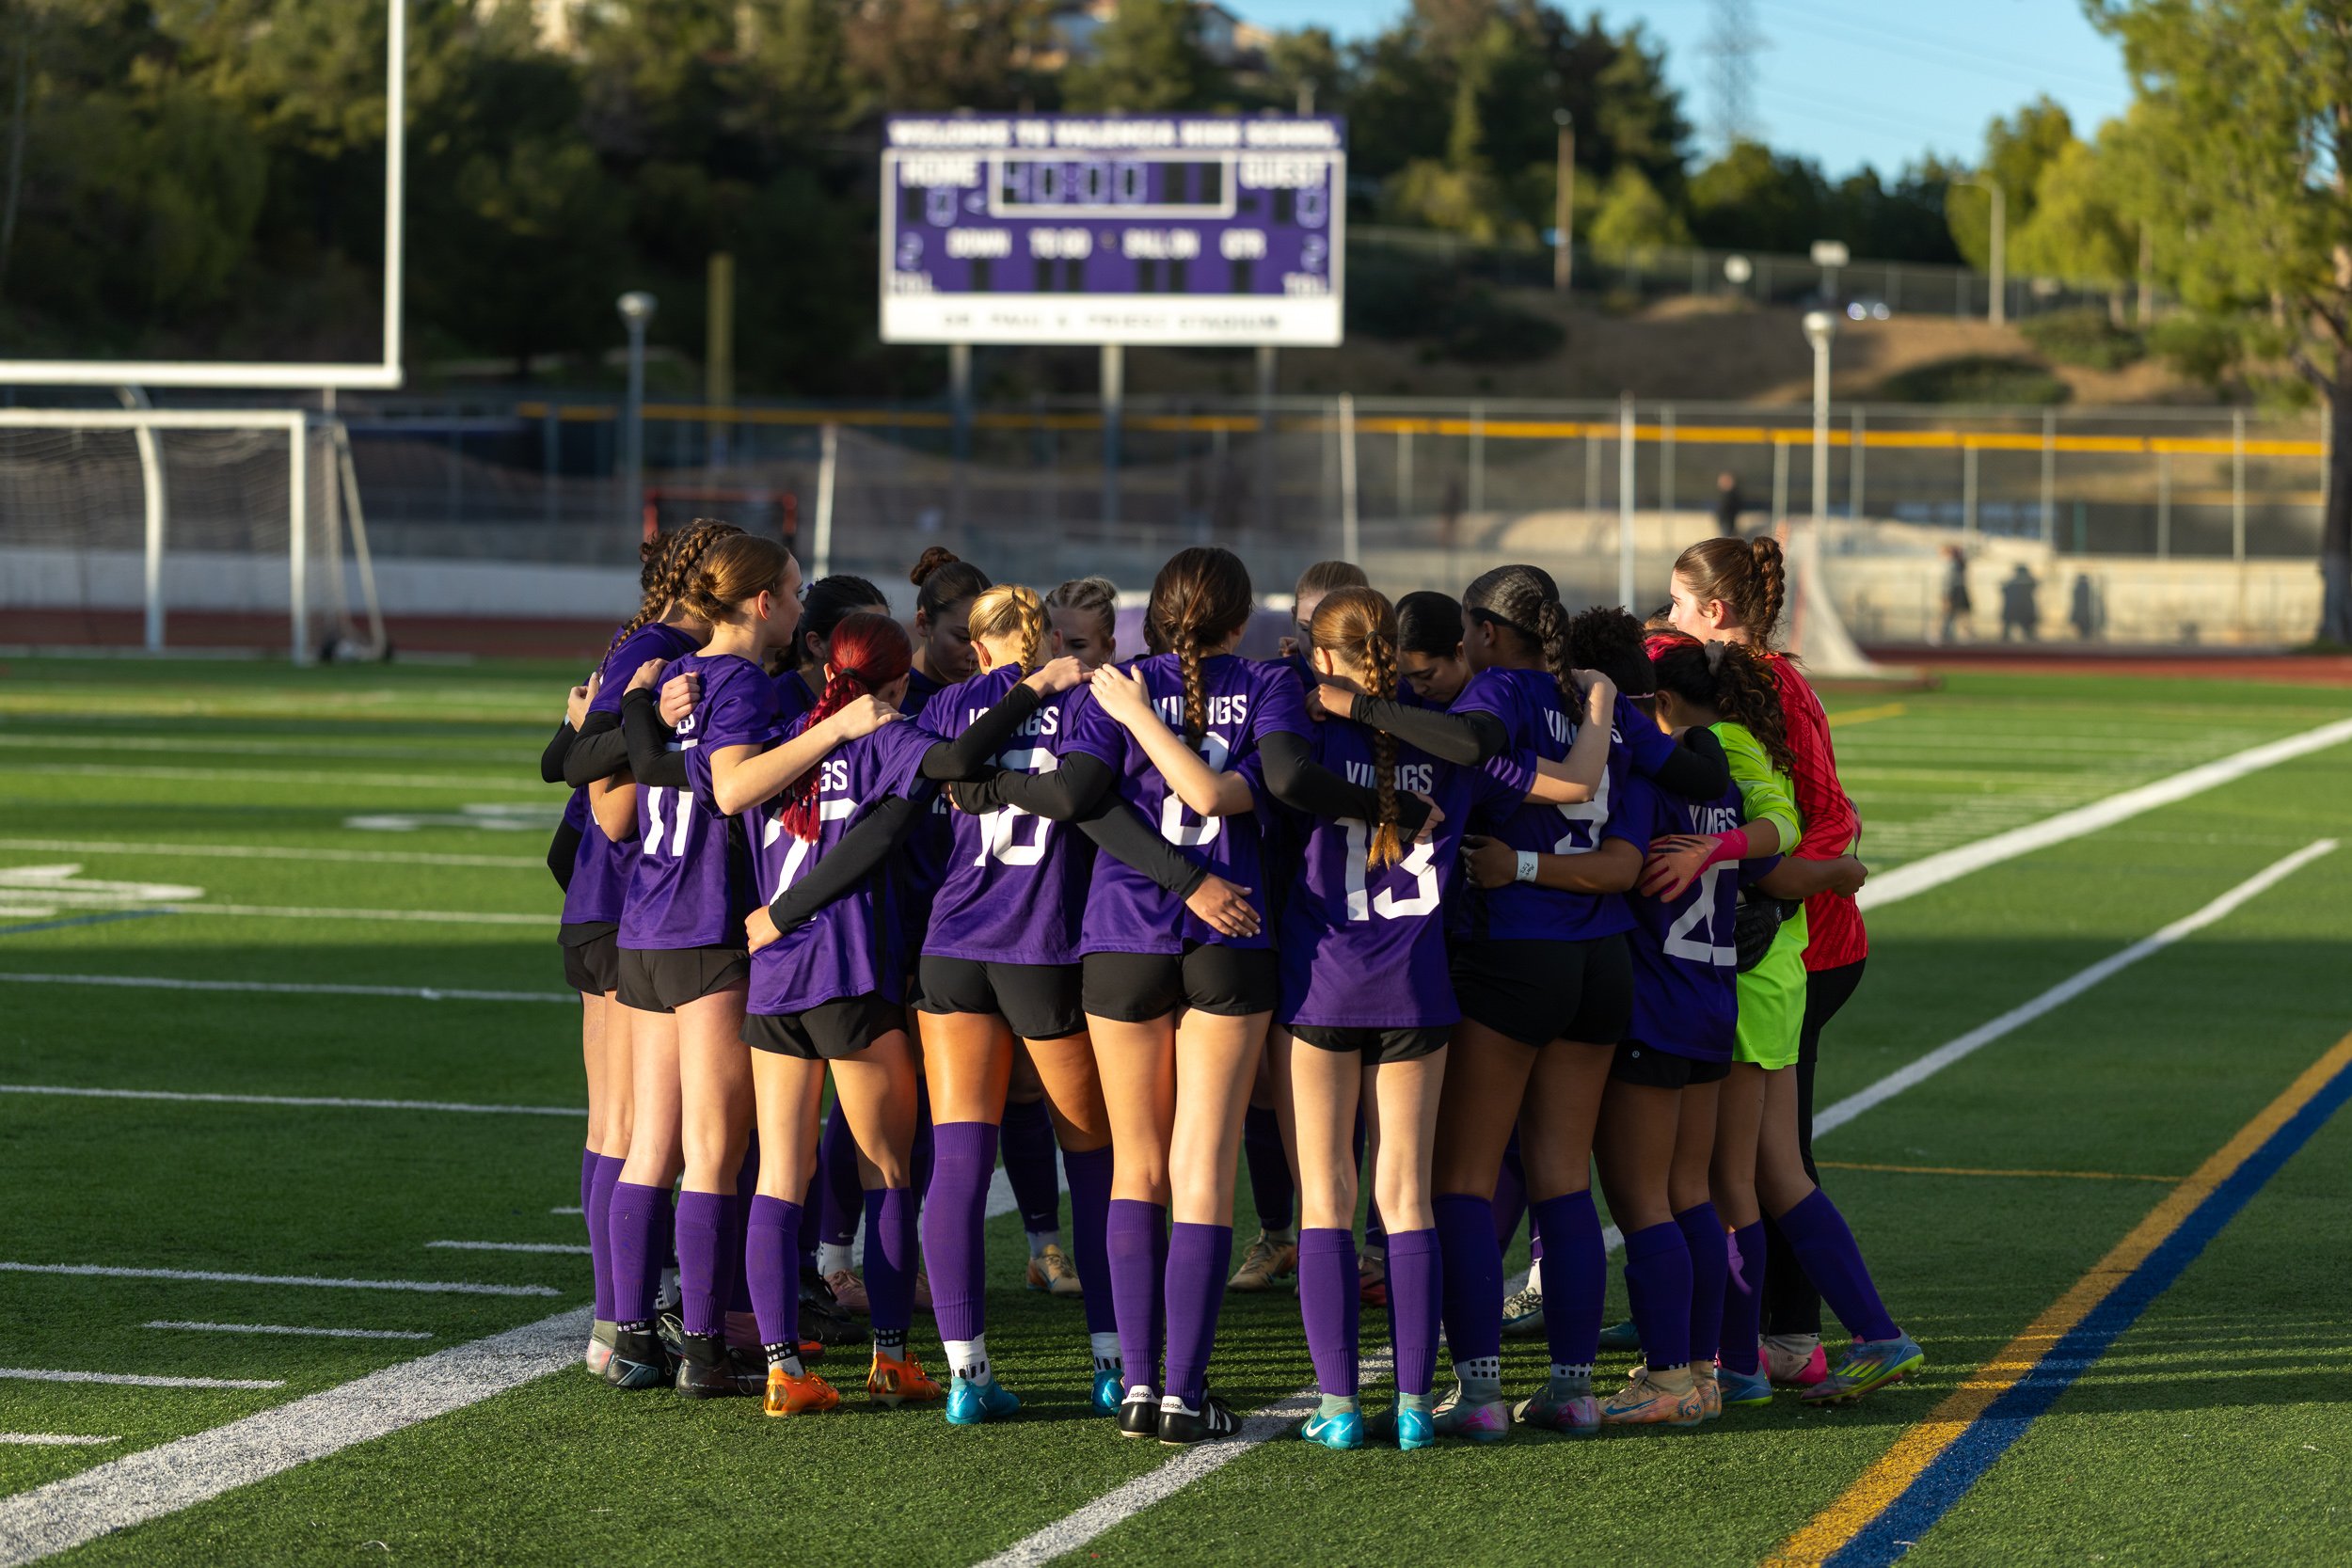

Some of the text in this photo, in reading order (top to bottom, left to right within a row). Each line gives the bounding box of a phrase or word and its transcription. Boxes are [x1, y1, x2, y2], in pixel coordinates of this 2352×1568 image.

[900, 154, 979, 186] HOME
[1240, 154, 1327, 187] GUEST
[946, 229, 1011, 258] DOWN
[1162, 1401, 1184, 1410] adidas
